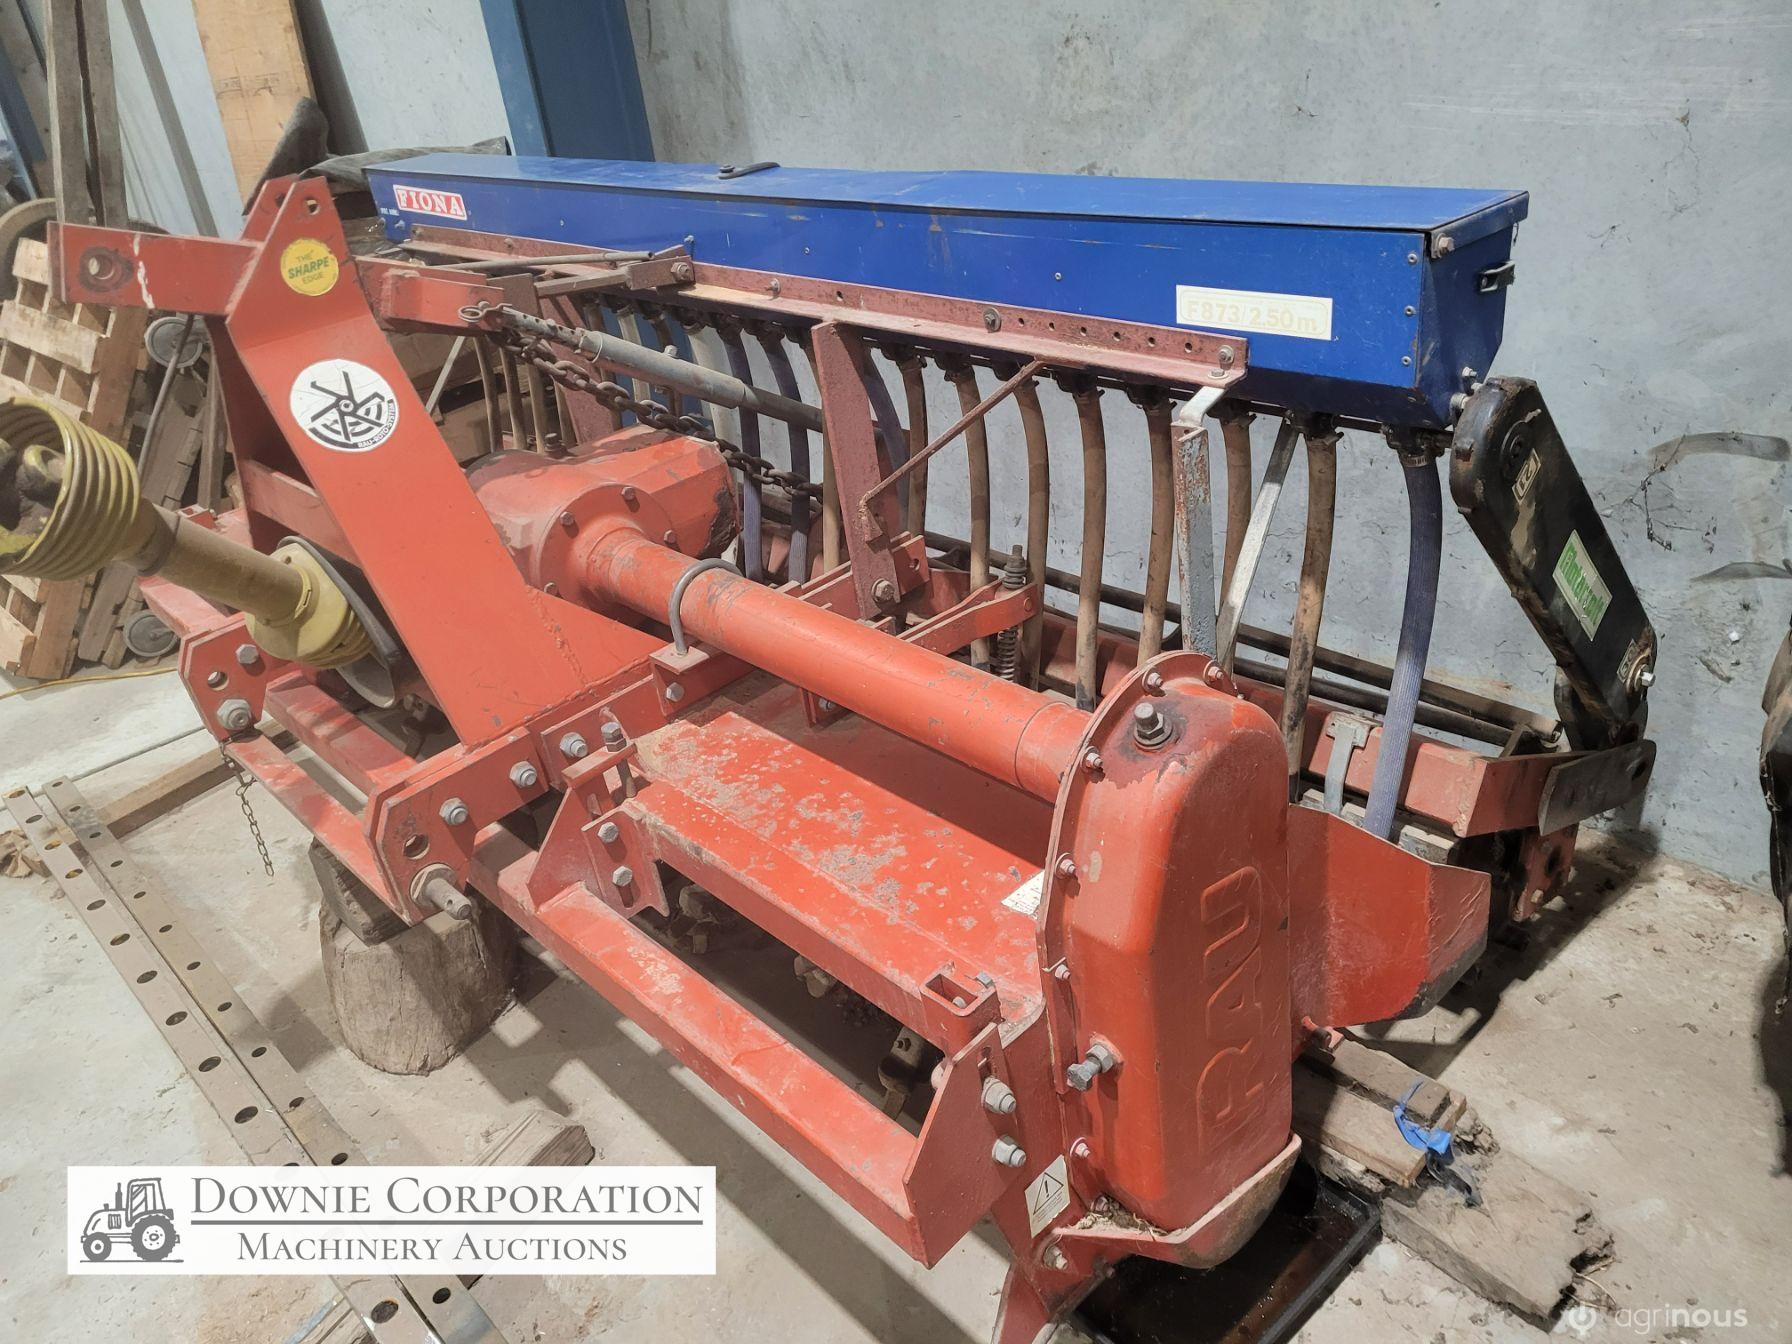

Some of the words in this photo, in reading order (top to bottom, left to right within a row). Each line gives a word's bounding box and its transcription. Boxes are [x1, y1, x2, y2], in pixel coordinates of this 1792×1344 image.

[396, 189, 463, 216] FIONA
[288, 256, 329, 279] SHARPE
[1196, 866, 1265, 1152] RAU
